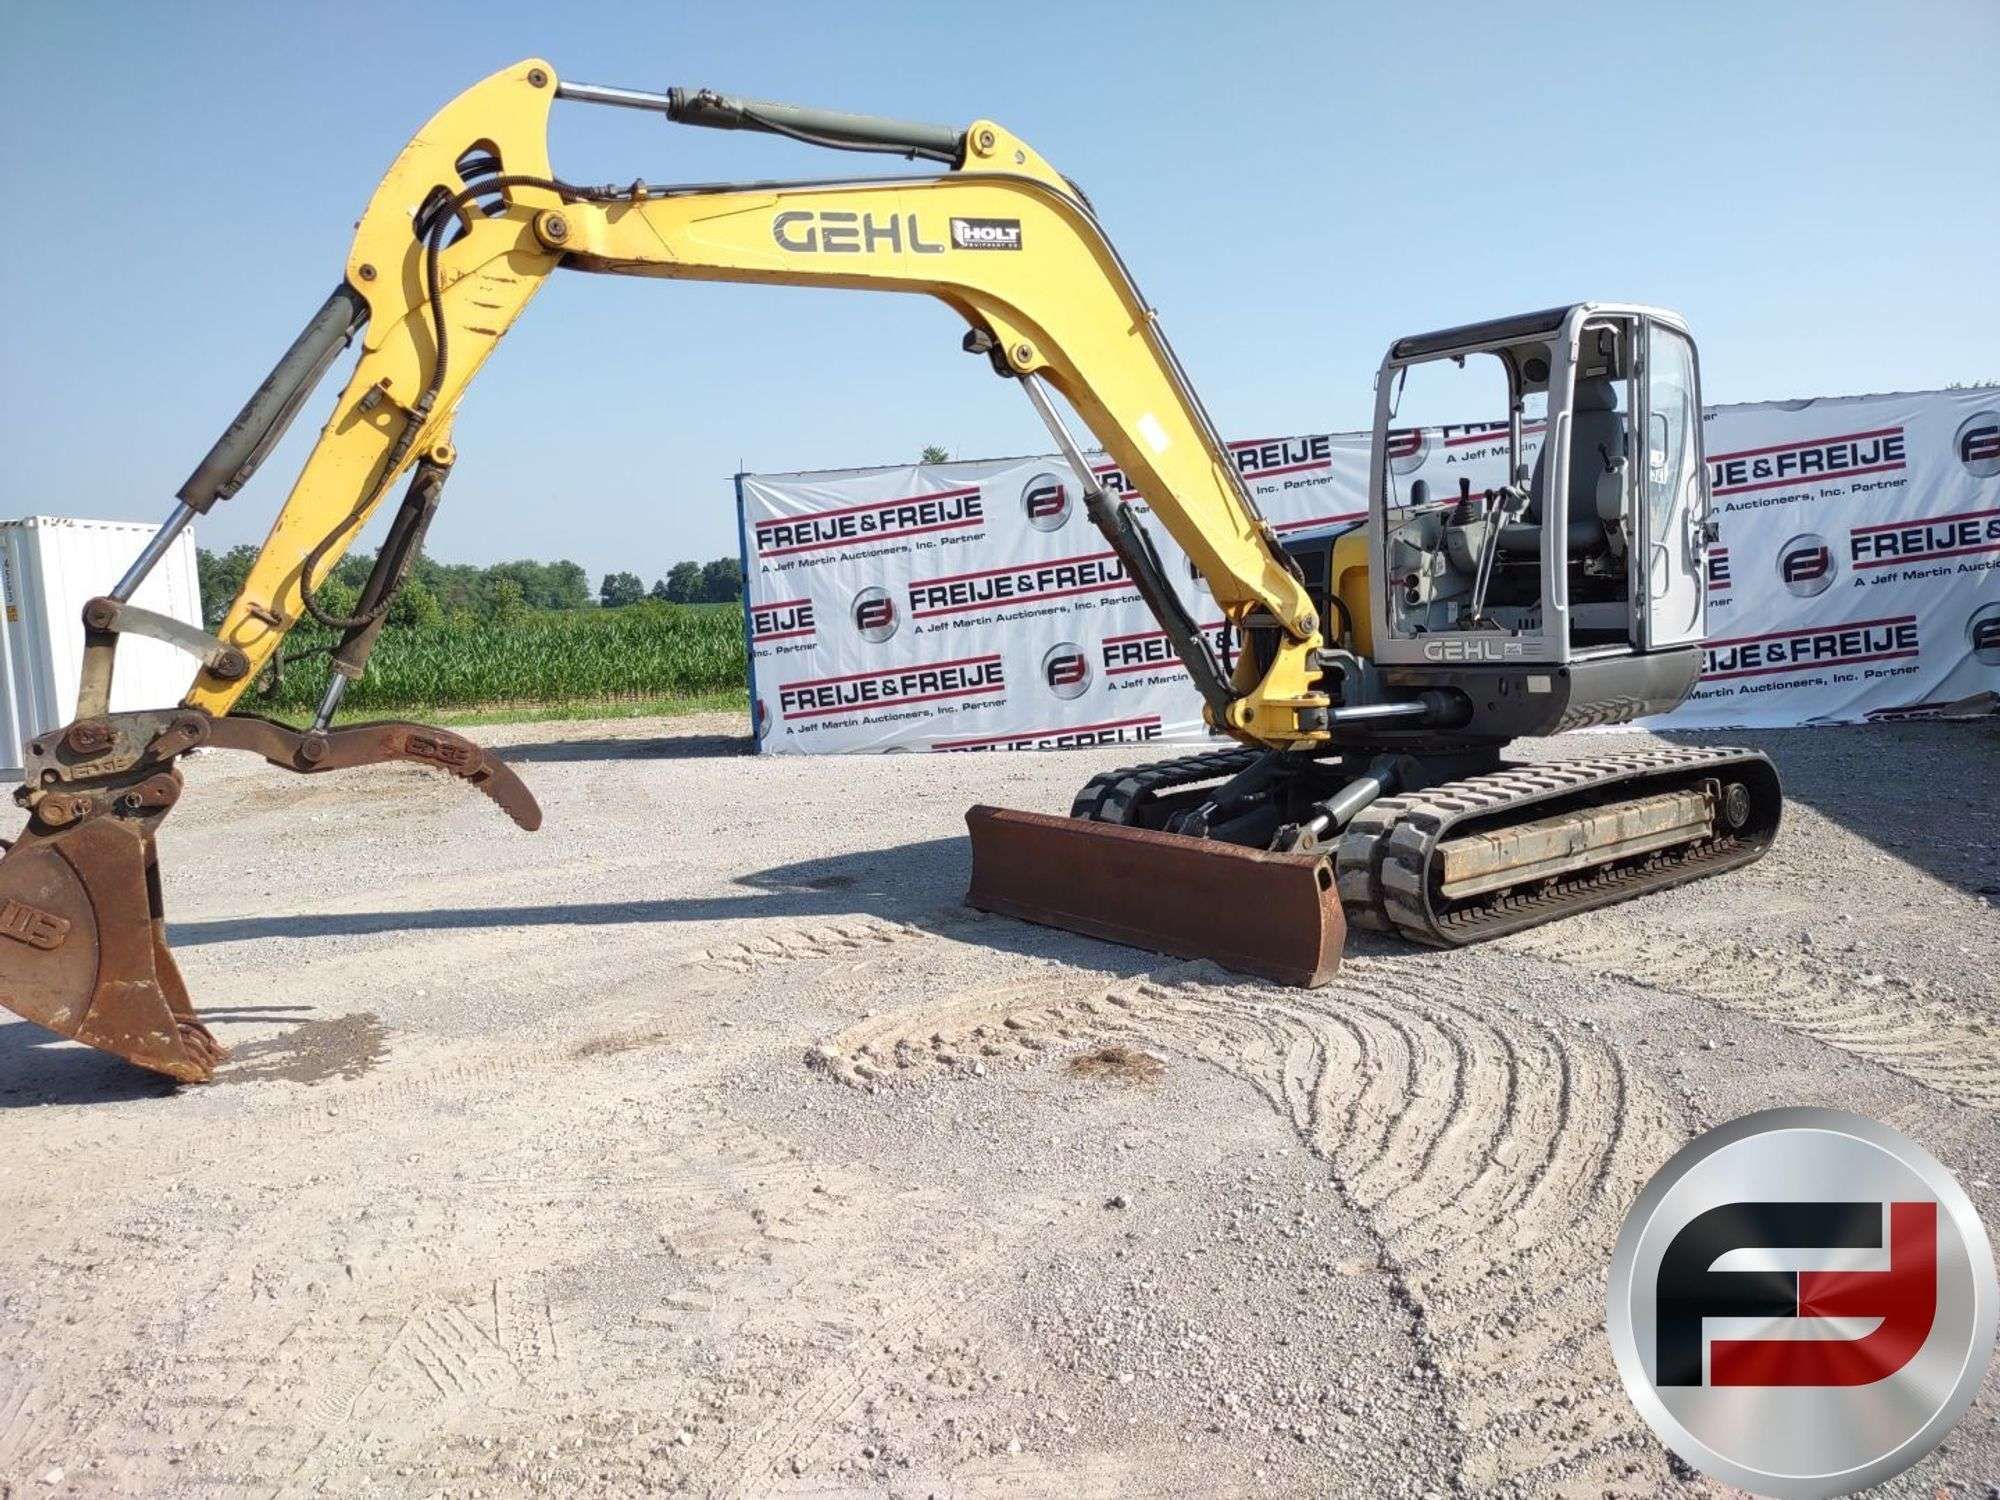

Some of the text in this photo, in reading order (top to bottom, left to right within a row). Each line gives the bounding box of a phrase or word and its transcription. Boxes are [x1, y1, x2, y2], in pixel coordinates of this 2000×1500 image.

[772, 211, 945, 253] GEHL
[964, 227, 1020, 240] HOLT
[1231, 437, 1331, 472] REIJE
[1461, 448, 1486, 461] Jeff
[1257, 475, 1333, 495] Inc. Partner
[1724, 491, 1815, 512] Auctioneers,
[1820, 488, 1846, 499] Inc.
[1851, 477, 1908, 494] Partner
[774, 561, 794, 572] Jeff
[798, 555, 836, 569] Martin
[840, 544, 912, 561] Auctioneers,
[916, 540, 937, 550] Inc.
[941, 532, 986, 547] Partner
[1871, 572, 1898, 585] Jeff
[1903, 566, 1952, 580] Martin
[927, 621, 949, 633] Jeff
[952, 615, 991, 630] Martin
[996, 607, 1071, 622] Auctioneers,
[1074, 602, 1097, 610] Inc.
[1101, 594, 1144, 607] Partne
[775, 642, 817, 655] Partner
[1423, 640, 1502, 661] GEHL
[1120, 677, 1144, 689] Jeff
[1147, 672, 1189, 686] Martin
[1739, 678, 1828, 694] Auctioneers,
[1833, 672, 1858, 683] Inc.
[1864, 665, 1920, 679] Partner
[797, 723, 818, 734] Jeff
[822, 717, 858, 731] Martin
[862, 708, 933, 725] Auctioneers,
[937, 705, 958, 714] Inc.
[962, 697, 1007, 712] Partner
